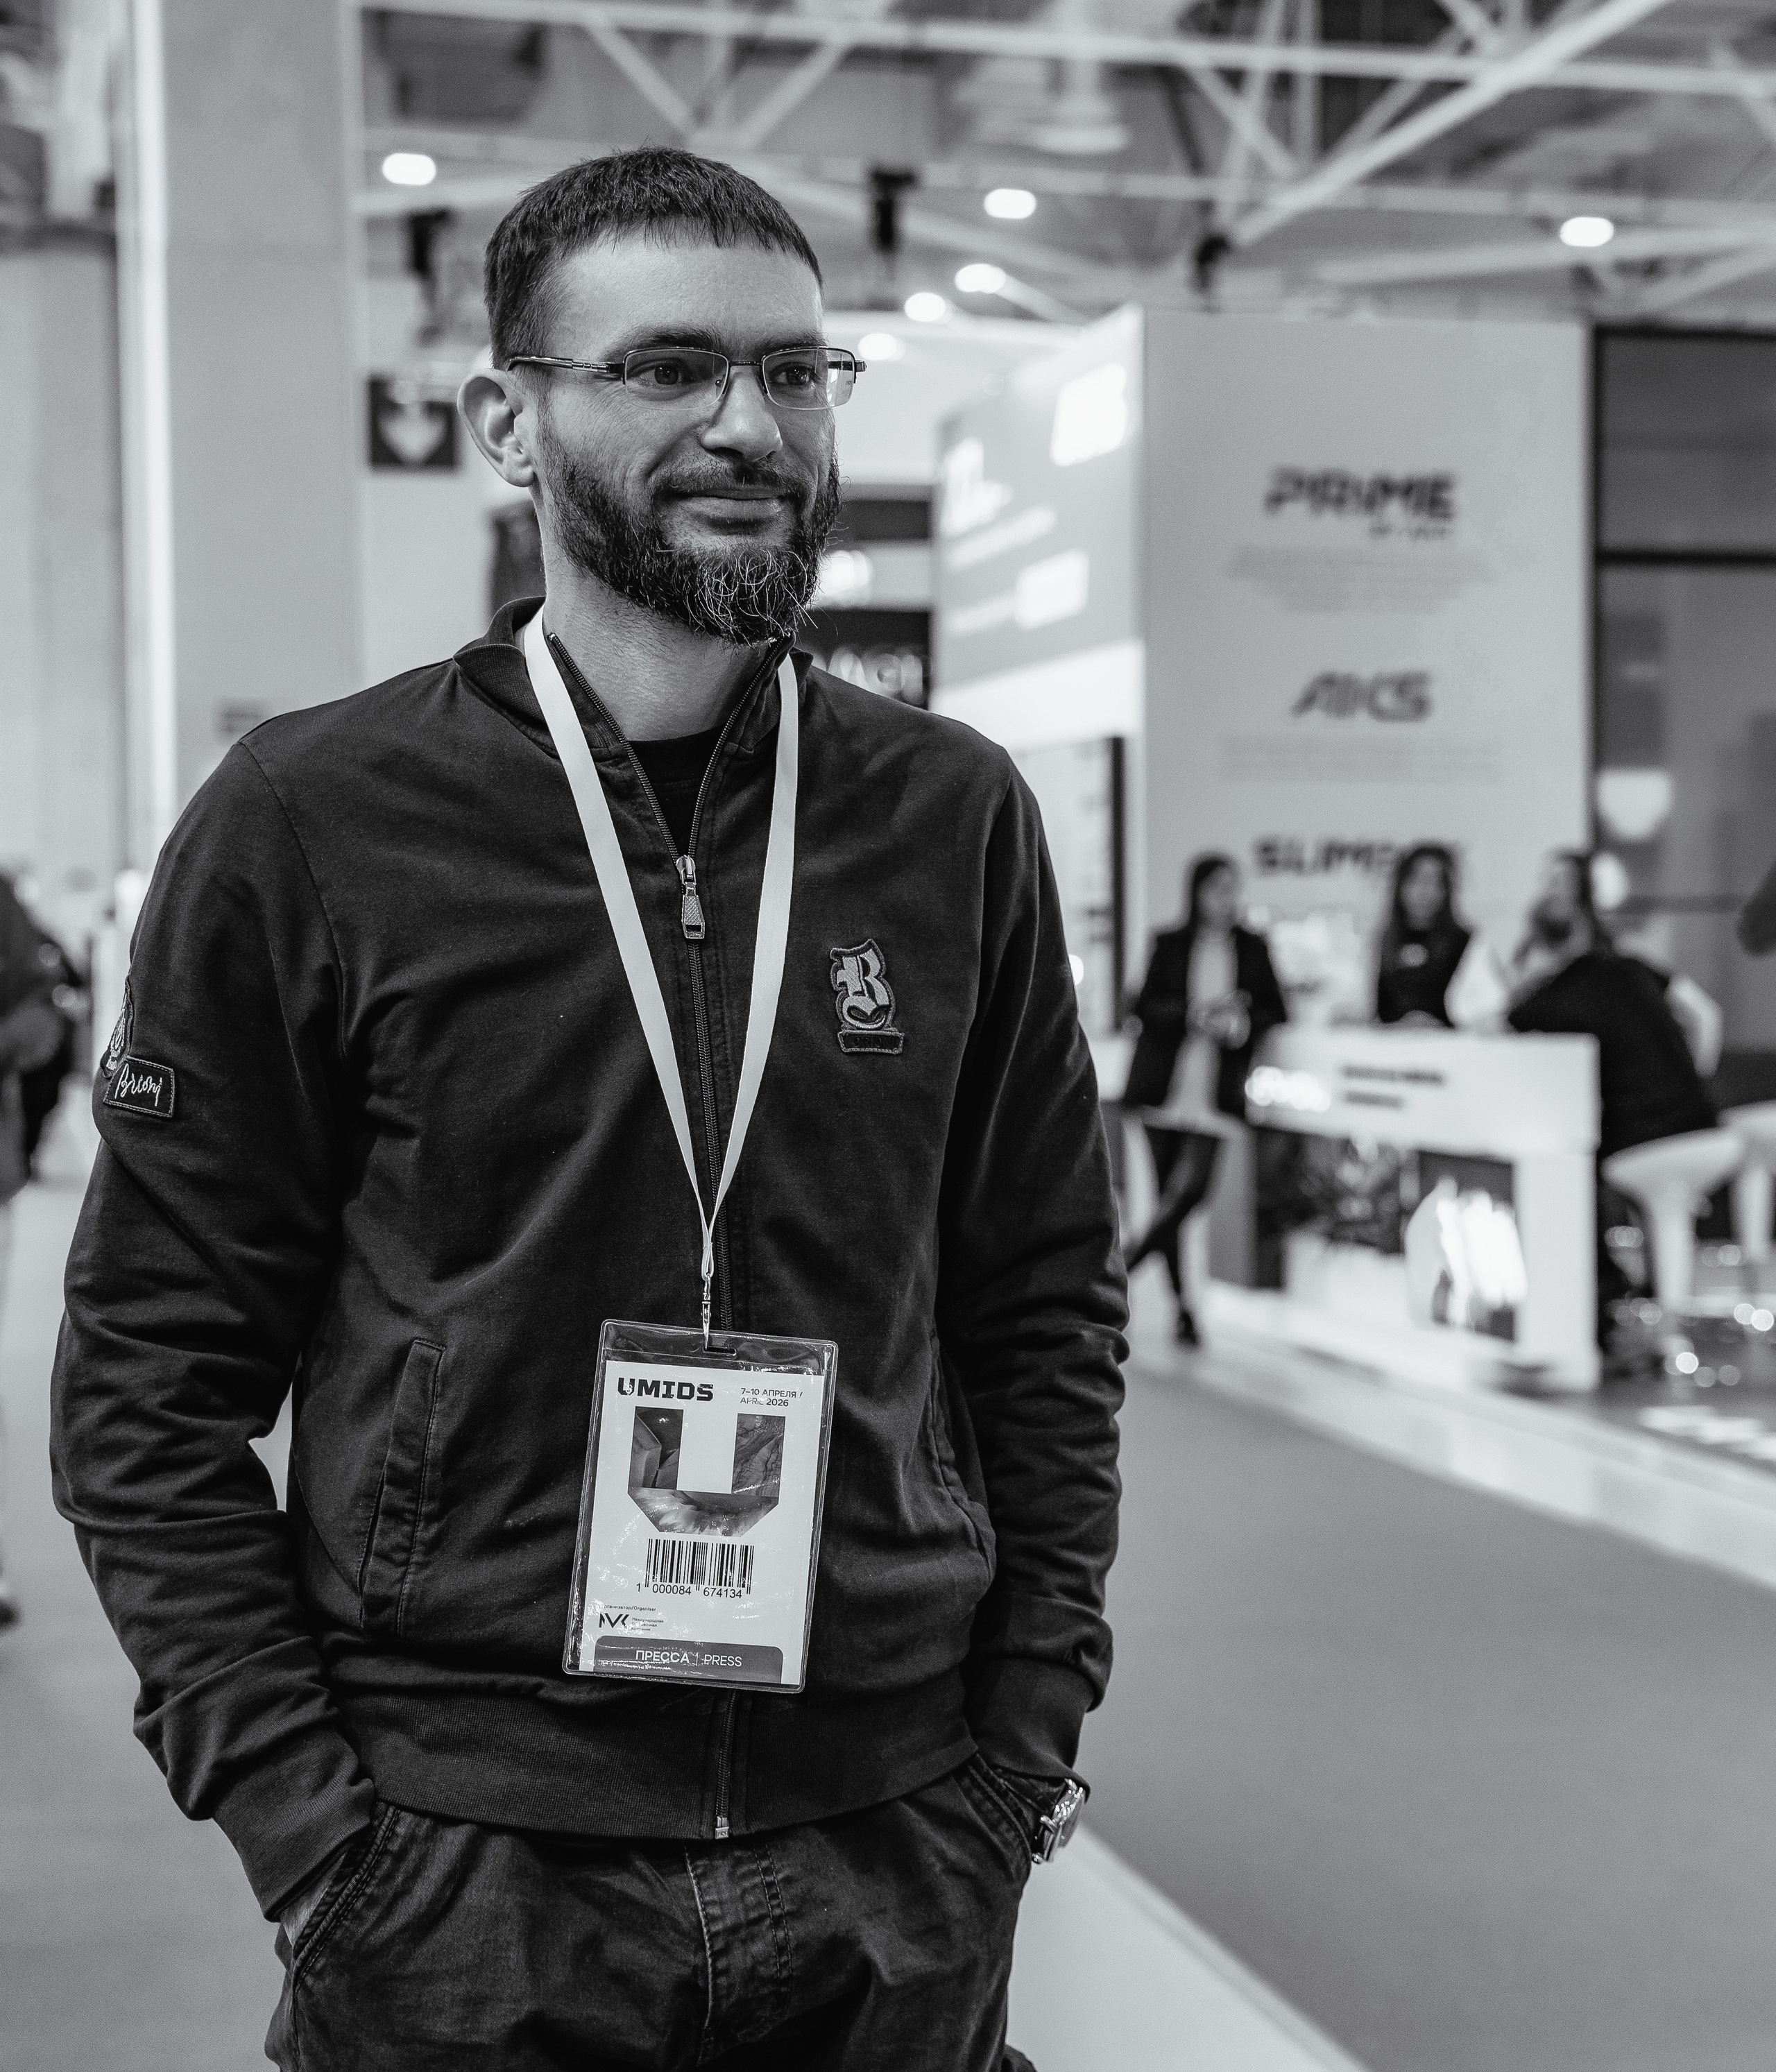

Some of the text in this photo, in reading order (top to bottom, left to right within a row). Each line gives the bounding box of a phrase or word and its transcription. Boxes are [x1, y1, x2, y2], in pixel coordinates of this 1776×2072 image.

[617, 1378, 713, 1401] UMIDS
[762, 1389, 797, 1398] АПРЕЛЯ
[766, 1398, 789, 1407] 2026
[636, 1582, 742, 1599] 1 000084 674134
[635, 1650, 742, 1666] ПРЕССА PRESS
